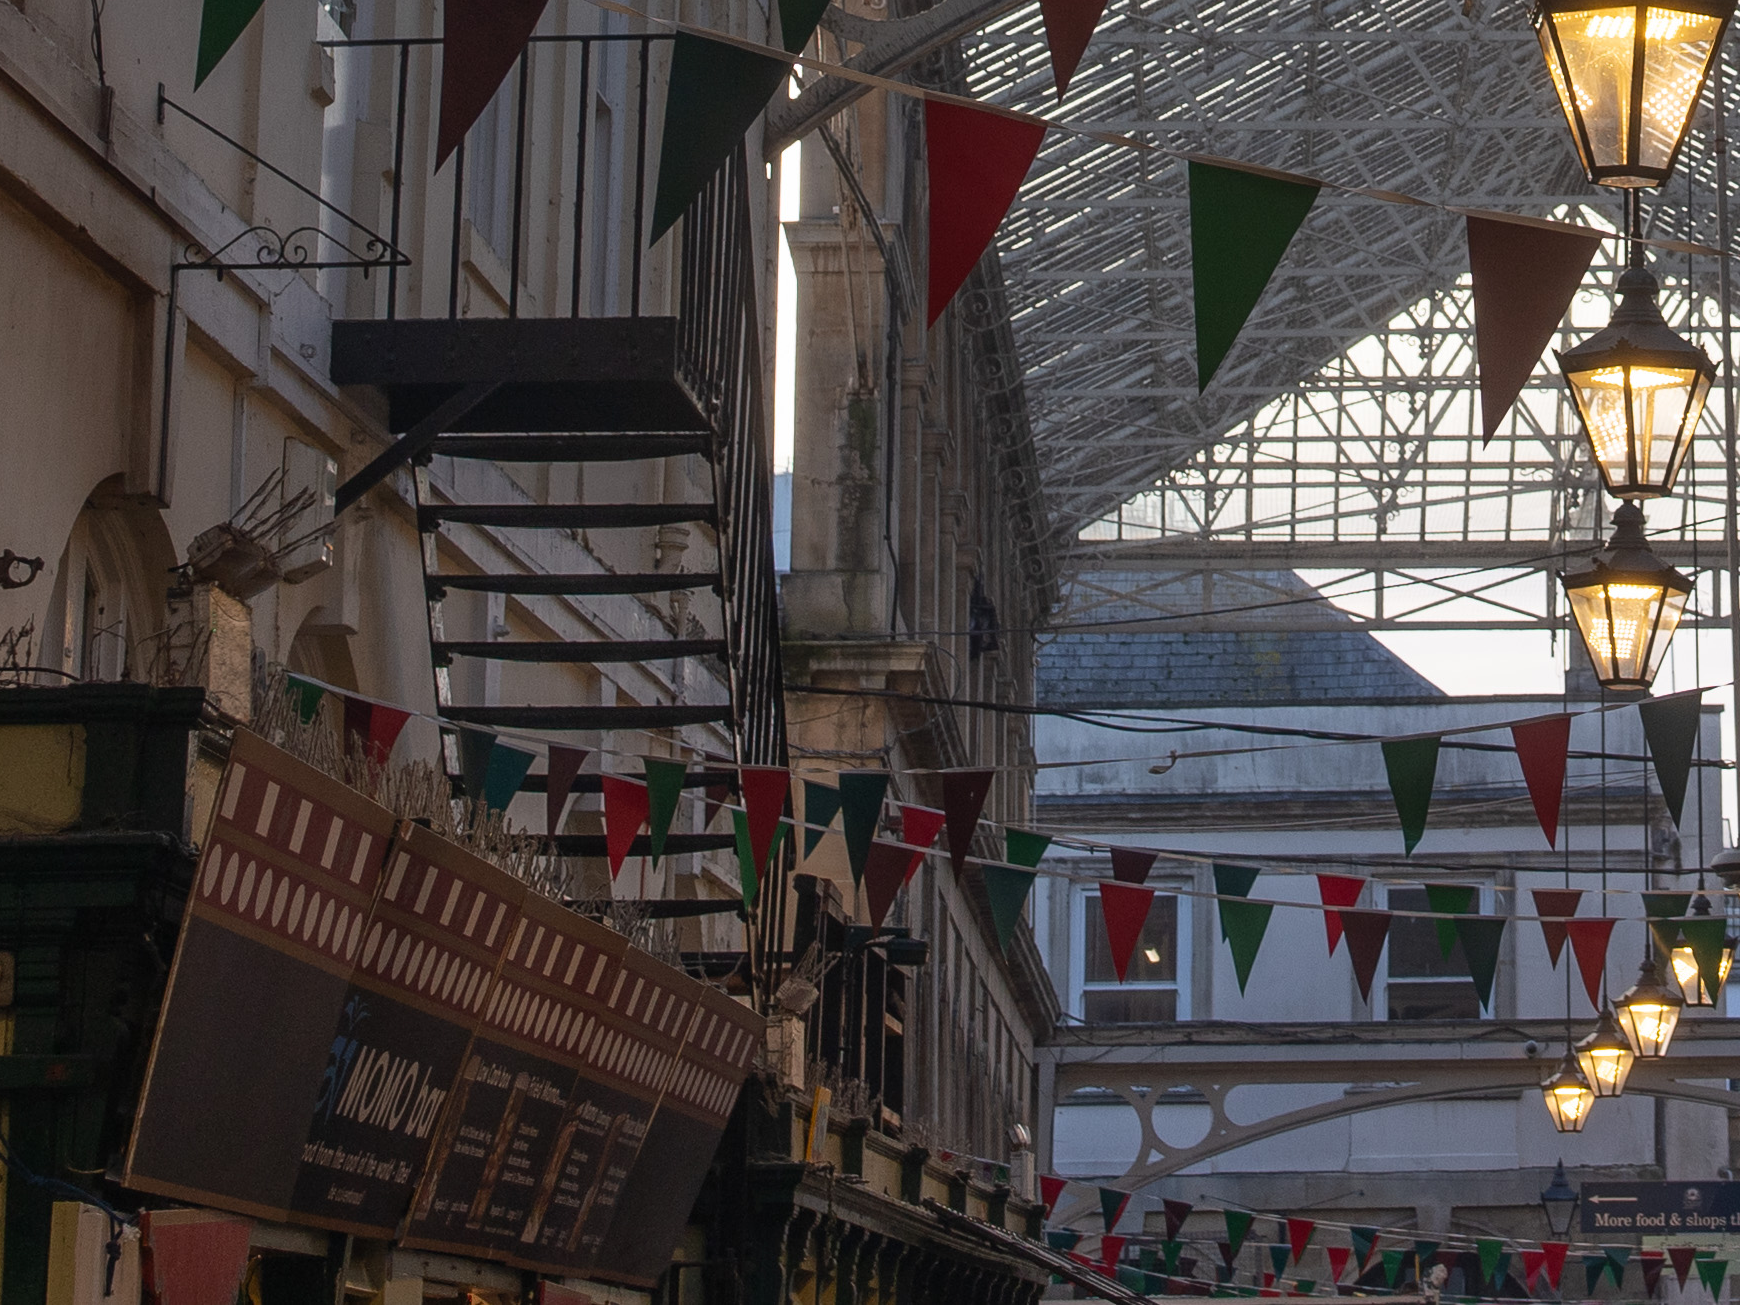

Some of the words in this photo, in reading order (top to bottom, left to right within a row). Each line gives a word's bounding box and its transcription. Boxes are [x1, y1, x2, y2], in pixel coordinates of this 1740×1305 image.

[335, 1045, 420, 1131] MOMO
[404, 1065, 447, 1139] bar
[1595, 1212, 1633, 1228] More
[1635, 1212, 1666, 1227] food
[1669, 1212, 1683, 1227] &
[1685, 1212, 1727, 1230] shops
